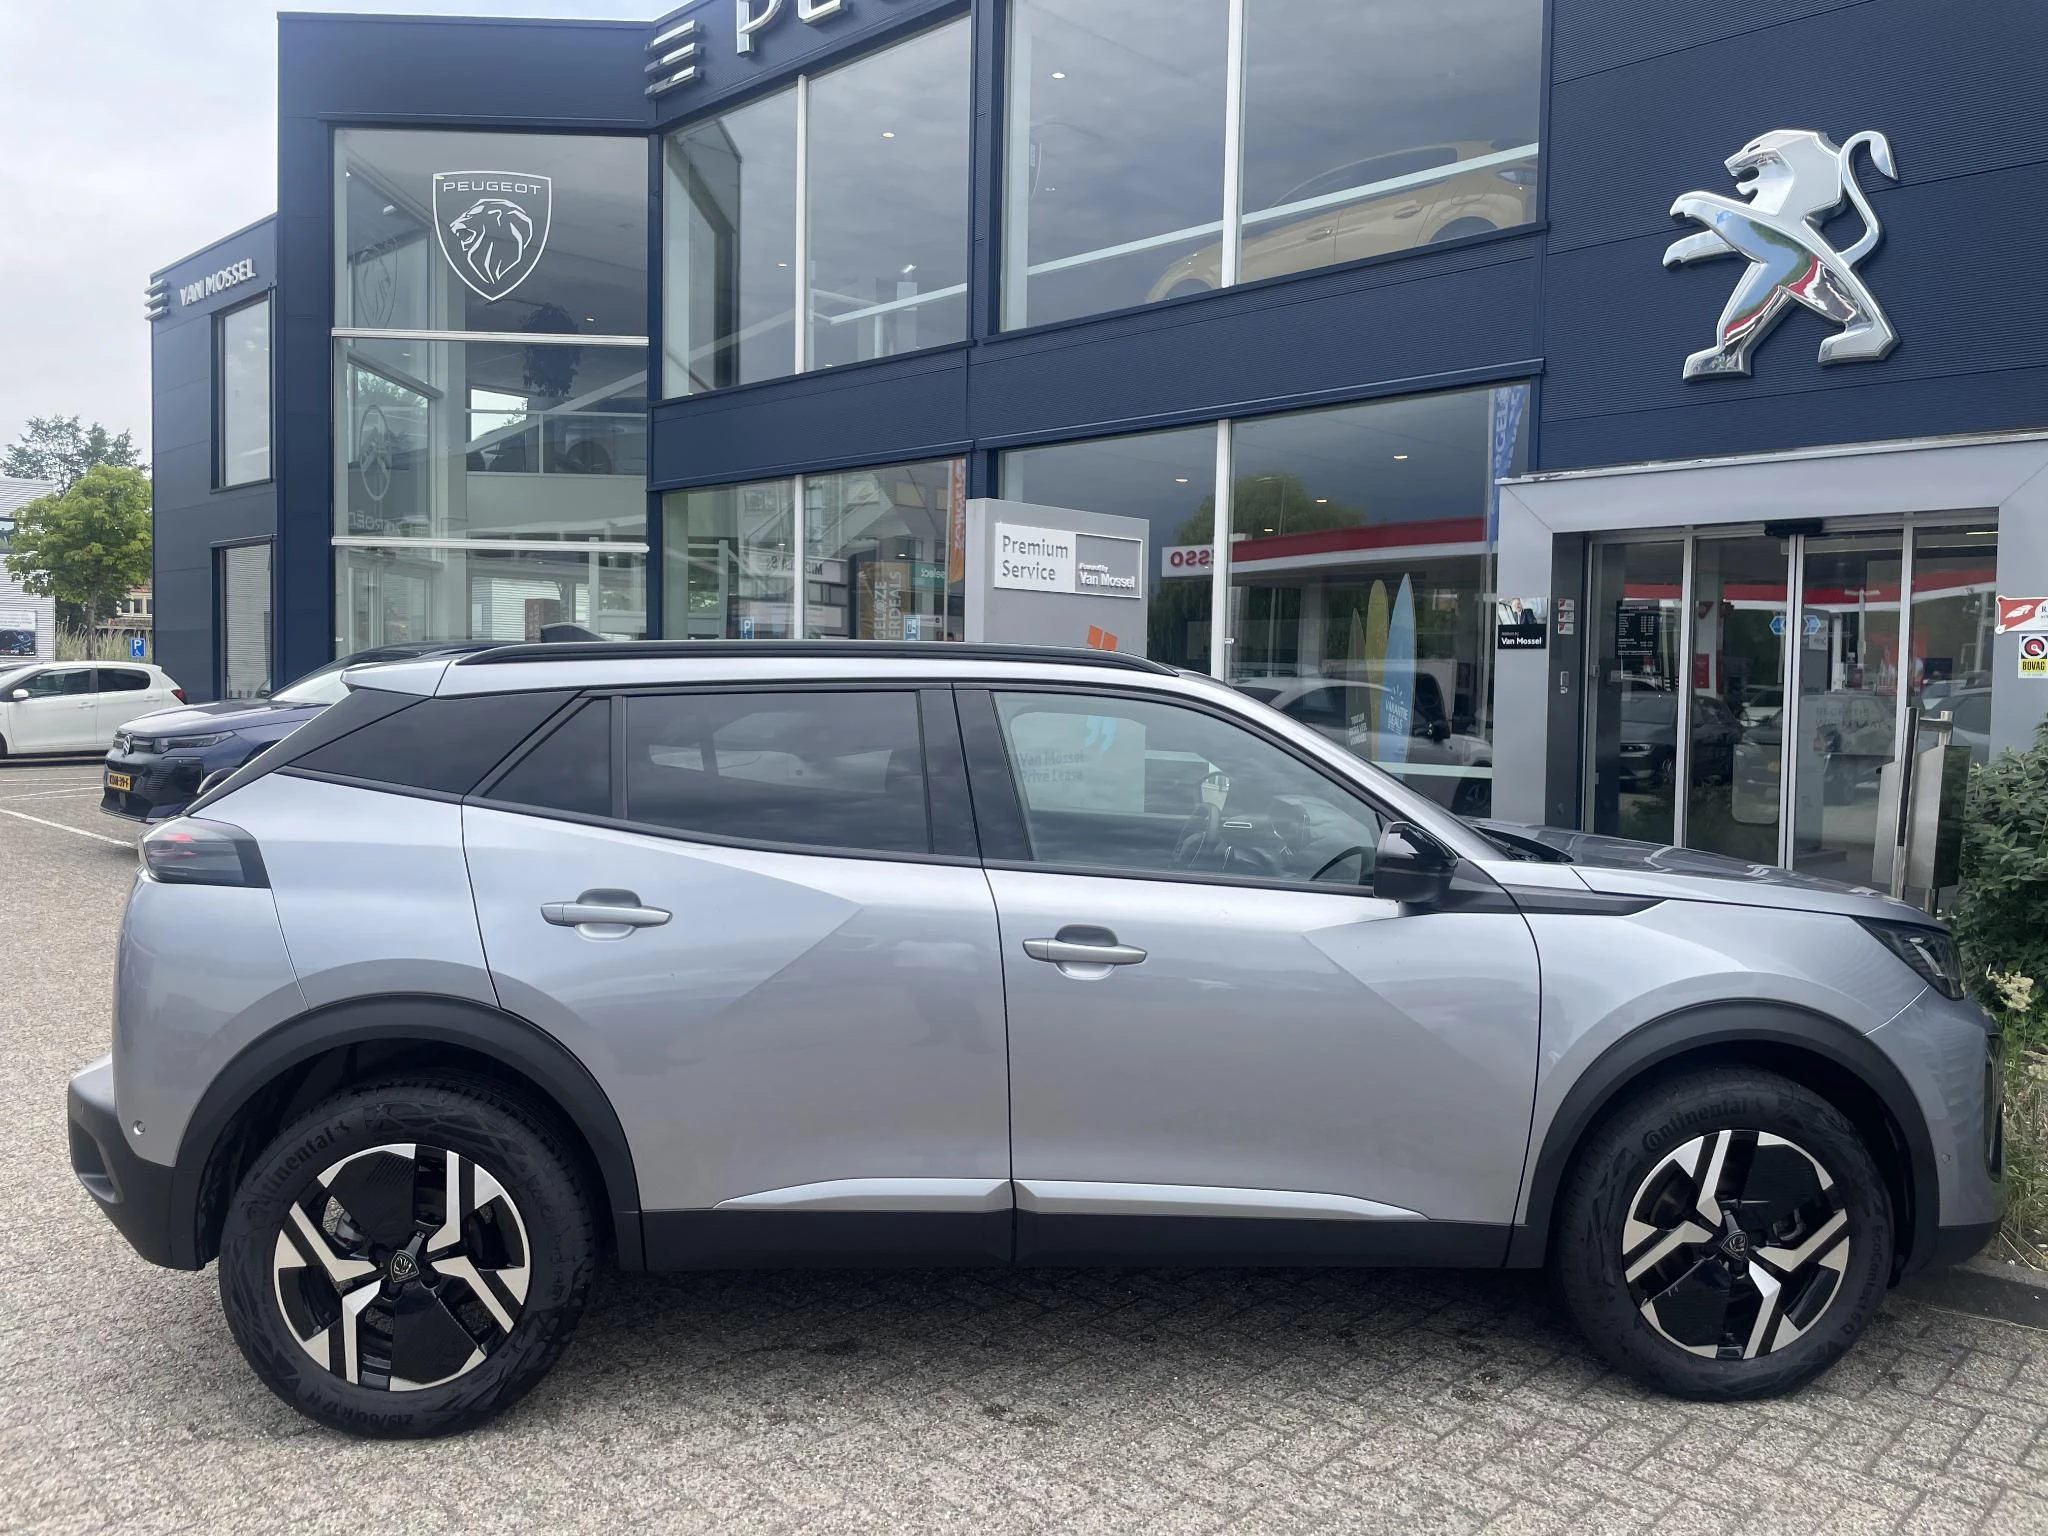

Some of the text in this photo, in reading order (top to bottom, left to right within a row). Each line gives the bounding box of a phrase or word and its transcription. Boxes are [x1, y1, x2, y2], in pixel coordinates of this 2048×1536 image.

[443, 180, 542, 195] PEUGEOT
[179, 258, 257, 307] VAN MOSSEL
[1002, 535, 1069, 559] Premium
[1002, 559, 1056, 581] Service
[1080, 571, 1136, 588] Van Mossel
[133, 639, 142, 650] P
[1501, 636, 1542, 645] Van Mossel
[2022, 660, 2045, 671] BOVAG
[1642, 1098, 1747, 1153] Continental
[1857, 1224, 1884, 1310] EcoContact
